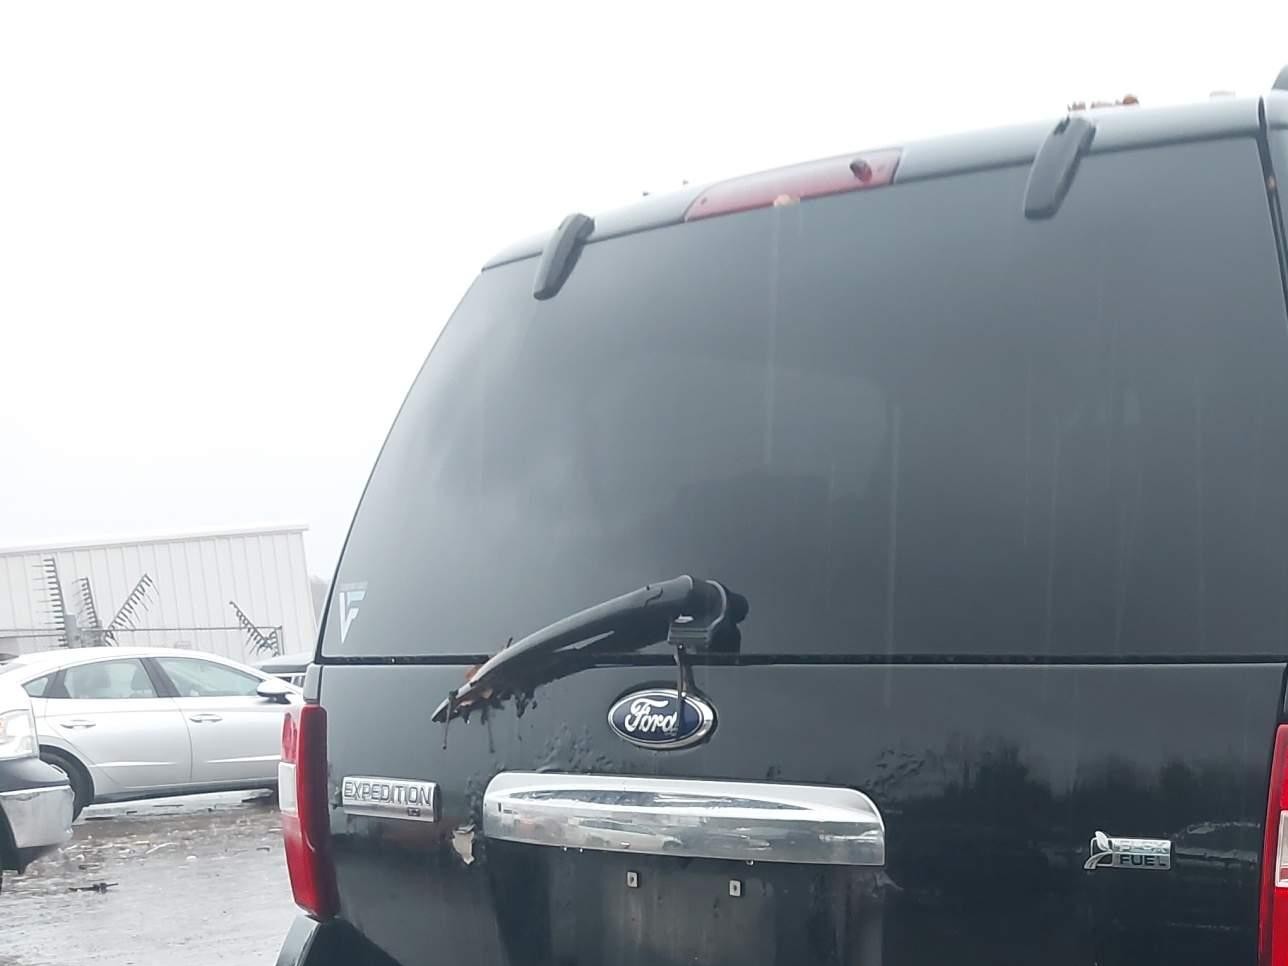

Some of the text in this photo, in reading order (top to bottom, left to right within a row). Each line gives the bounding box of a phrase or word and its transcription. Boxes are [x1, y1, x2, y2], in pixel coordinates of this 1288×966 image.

[624, 698, 678, 733] Ford
[343, 780, 432, 807] EXPEDITION
[1119, 854, 1168, 867] FUEL
